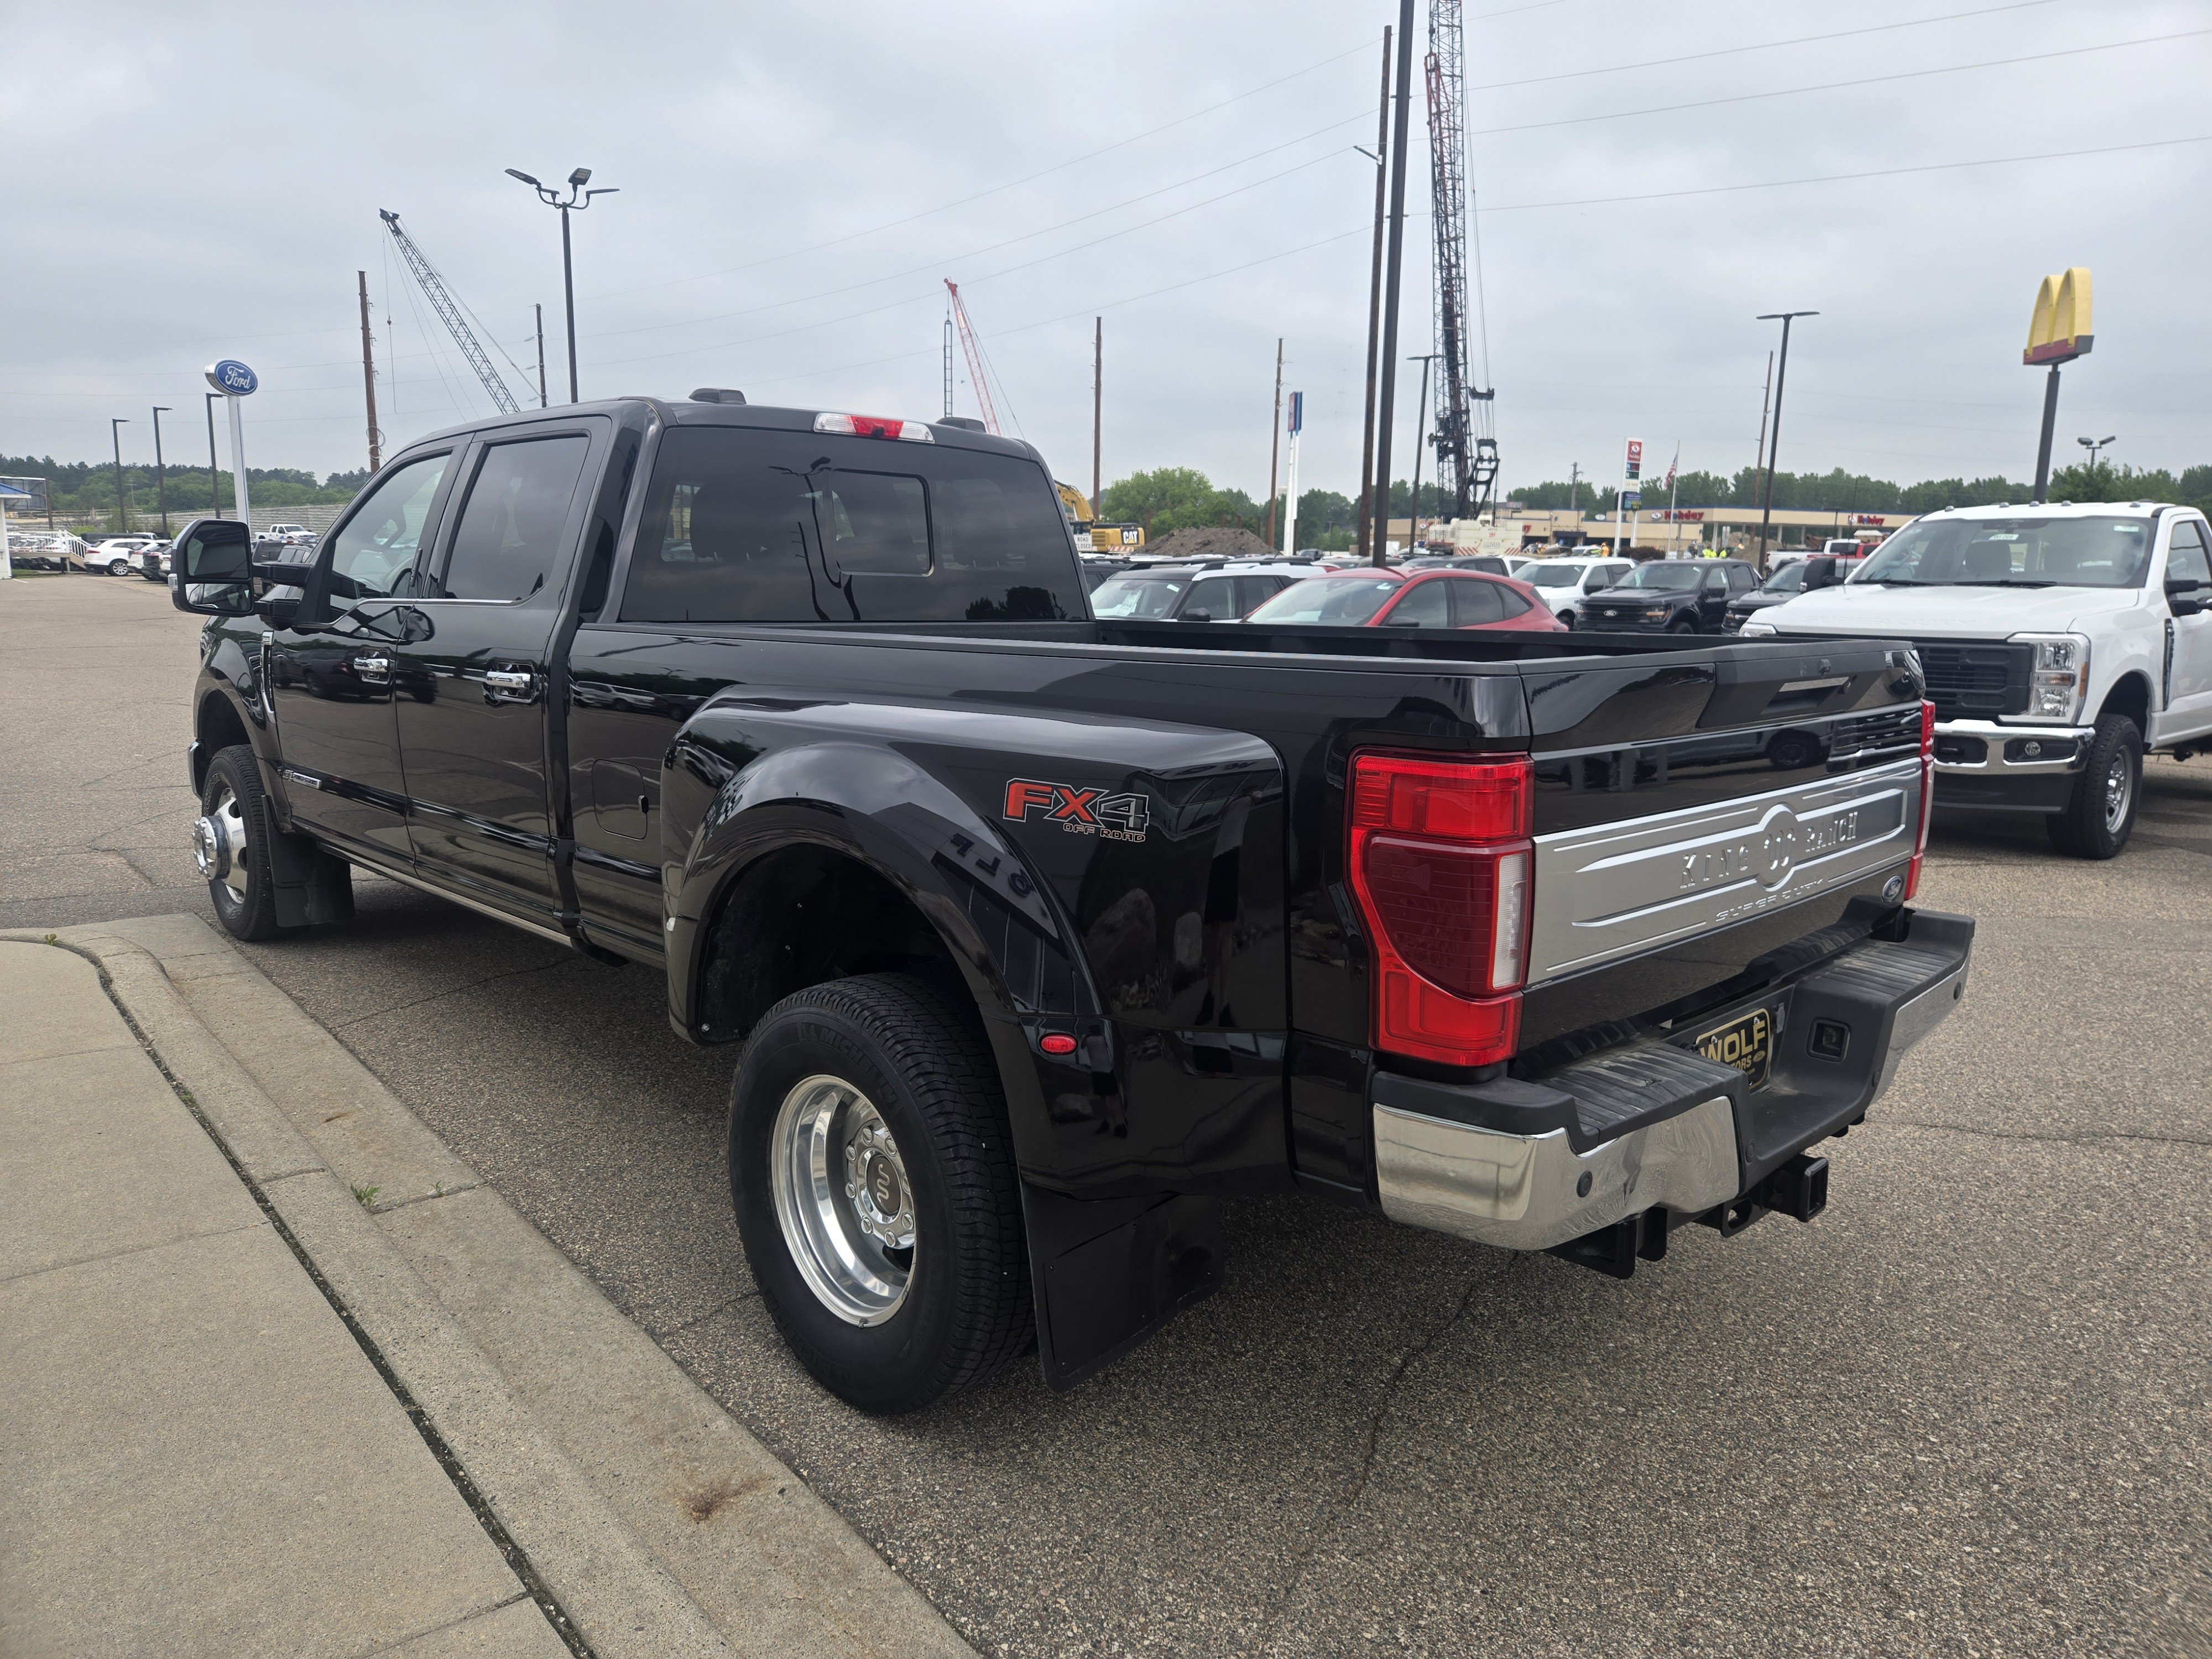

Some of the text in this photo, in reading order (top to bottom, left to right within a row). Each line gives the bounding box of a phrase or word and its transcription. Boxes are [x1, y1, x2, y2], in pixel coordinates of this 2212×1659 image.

[225, 366, 251, 389] Ford
[1123, 531, 1138, 544] CAT
[1003, 777, 1150, 834] FX4
[1063, 822, 1146, 843] OFF ROAD
[1679, 811, 1859, 889] KING RANCH
[1715, 878, 1824, 922] SUPER DUTY
[1700, 1020, 1766, 1063] WOLF
